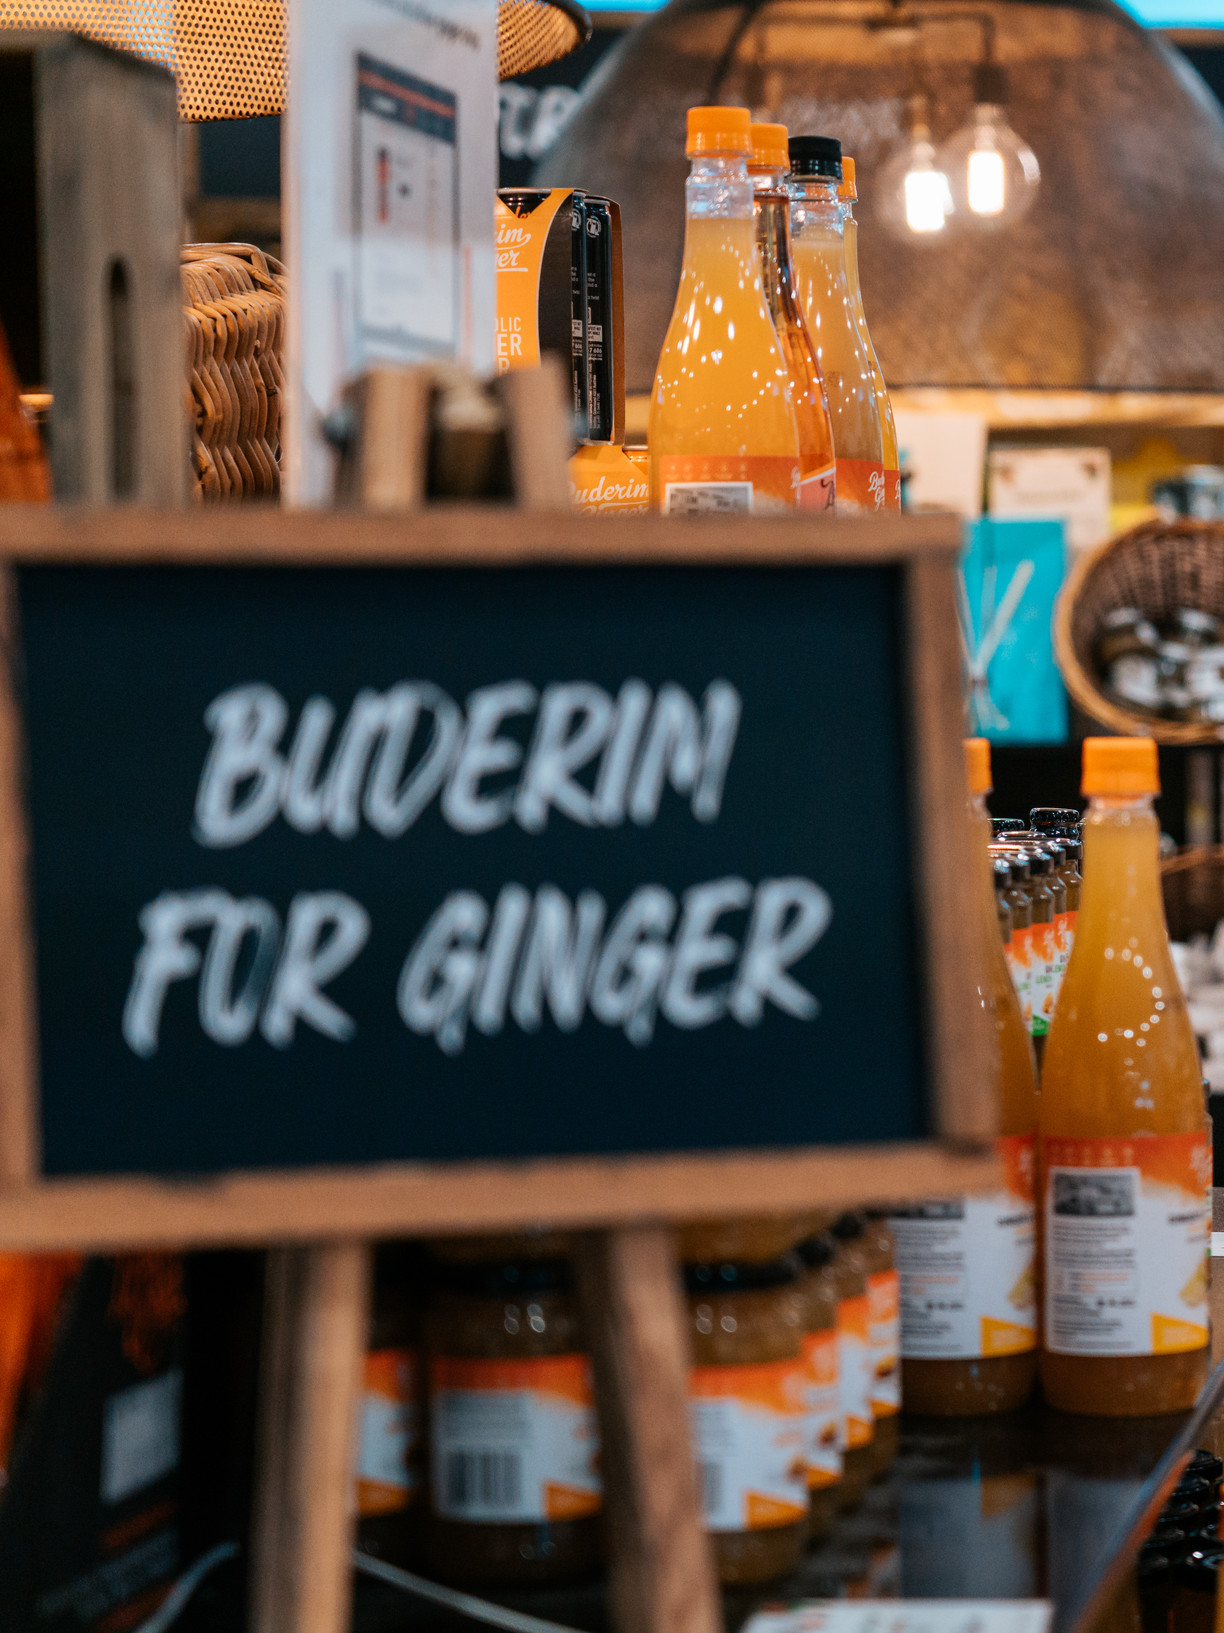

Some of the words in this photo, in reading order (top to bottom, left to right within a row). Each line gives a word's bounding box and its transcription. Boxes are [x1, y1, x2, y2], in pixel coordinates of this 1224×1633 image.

[194, 680, 741, 847] BUDERIM
[122, 887, 370, 1057] FOR
[397, 876, 832, 1054] GINGER
